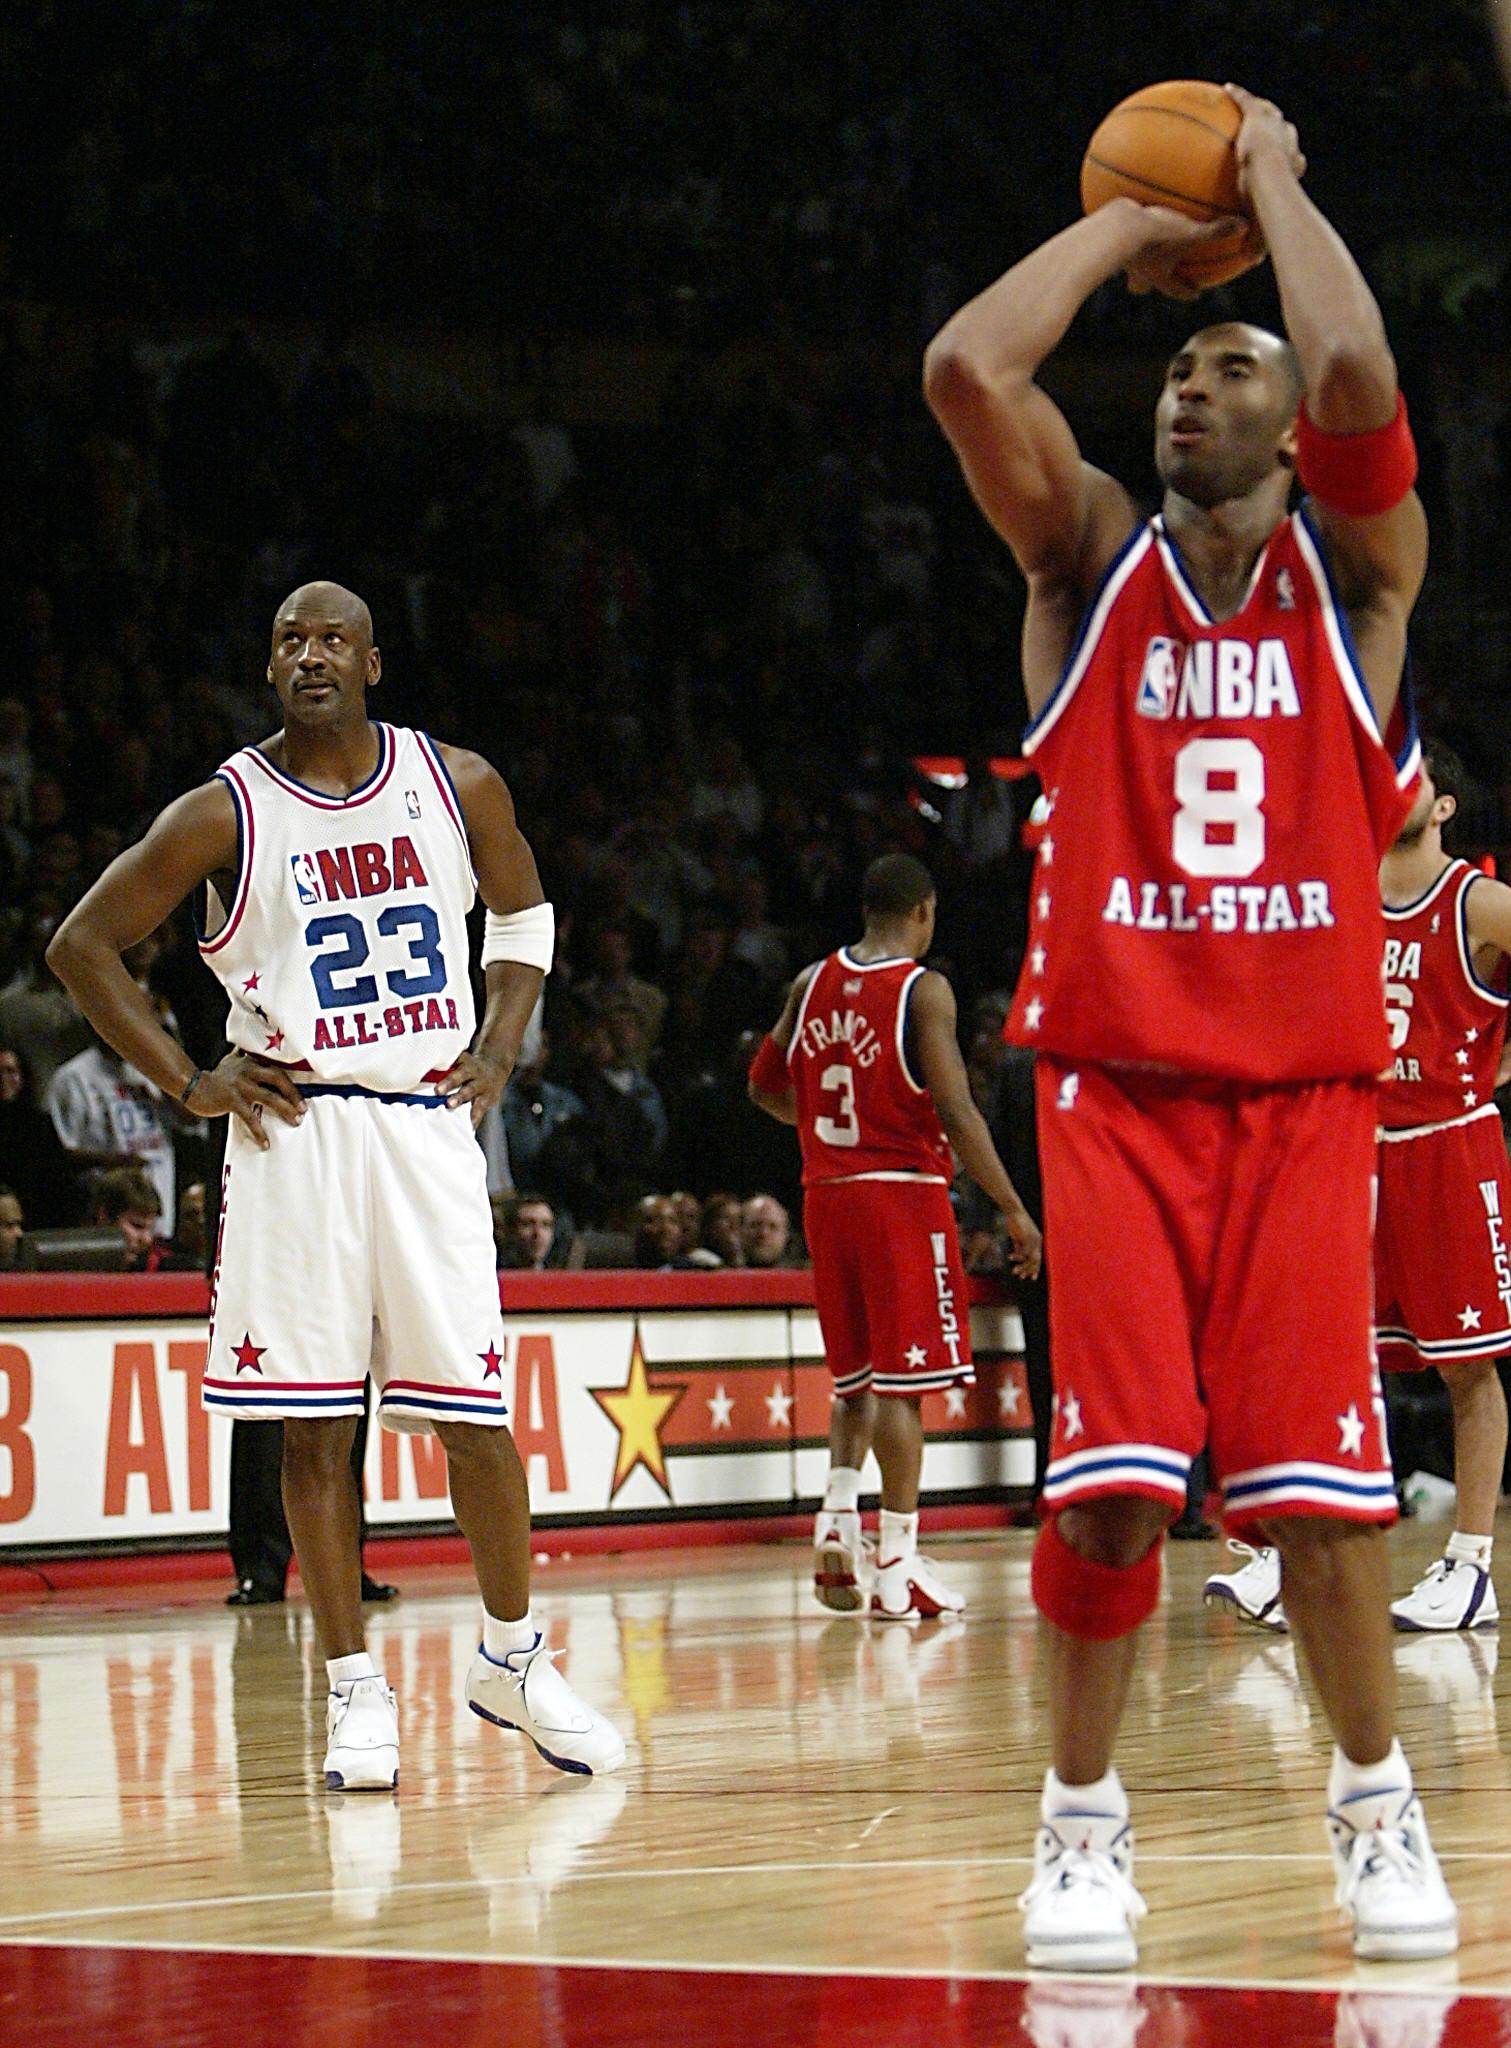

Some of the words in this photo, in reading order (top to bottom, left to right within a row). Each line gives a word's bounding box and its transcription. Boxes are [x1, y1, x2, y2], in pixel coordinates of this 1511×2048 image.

[1176, 639, 1301, 720] NBA
[1172, 738, 1266, 878] 8
[315, 836, 428, 901] NBA
[1103, 877, 1335, 933] ALL-STAR
[305, 904, 448, 1009] 23
[1382, 938, 1422, 980] BA
[313, 998, 460, 1050] ALL-STAR
[814, 1064, 860, 1147] 3
[930, 1231, 961, 1366] WEST
